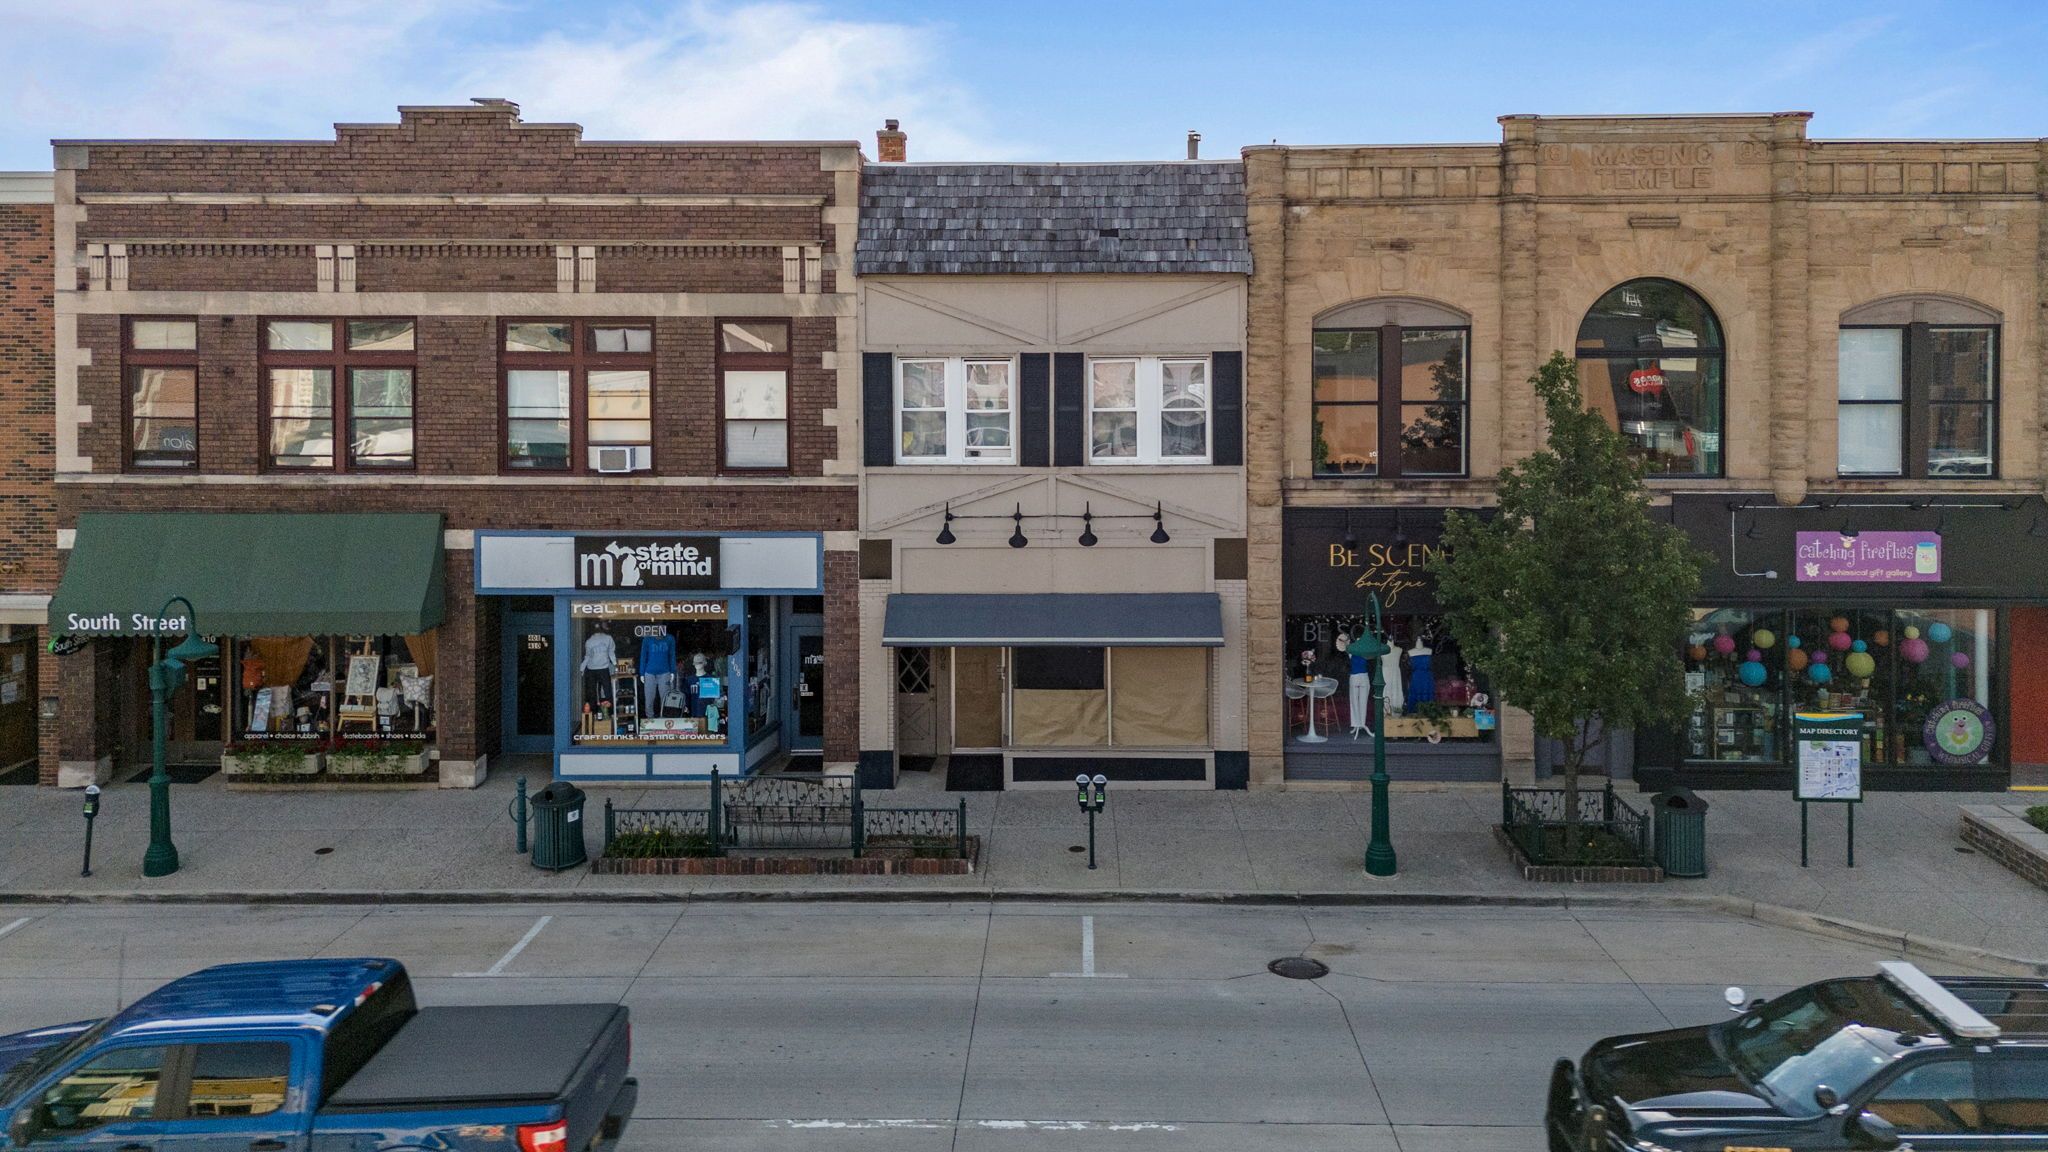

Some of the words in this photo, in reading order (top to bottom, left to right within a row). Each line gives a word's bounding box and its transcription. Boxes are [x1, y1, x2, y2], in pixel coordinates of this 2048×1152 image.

[1592, 144, 1714, 166] MASONIC
[1594, 167, 1714, 190] TEMPLE
[635, 542, 699, 561] state
[639, 559, 652, 570] of
[651, 556, 712, 576] mind
[1831, 568, 1868, 577] whimsical
[1869, 568, 1885, 579] gift
[1885, 568, 1913, 579] gallery
[1354, 567, 1426, 608] boutique
[67, 613, 121, 631] South
[132, 613, 187, 631] Street
[634, 625, 668, 637] OPEN
[1303, 622, 1329, 642] BE
[54, 639, 73, 653] South
[244, 732, 269, 741] apparel
[274, 732, 296, 740] choice
[297, 732, 321, 740] rubbish
[342, 732, 381, 740] skateboards
[385, 732, 404, 740] shoes
[409, 732, 427, 740] socks
[1816, 728, 1859, 736] DIRECTORY
